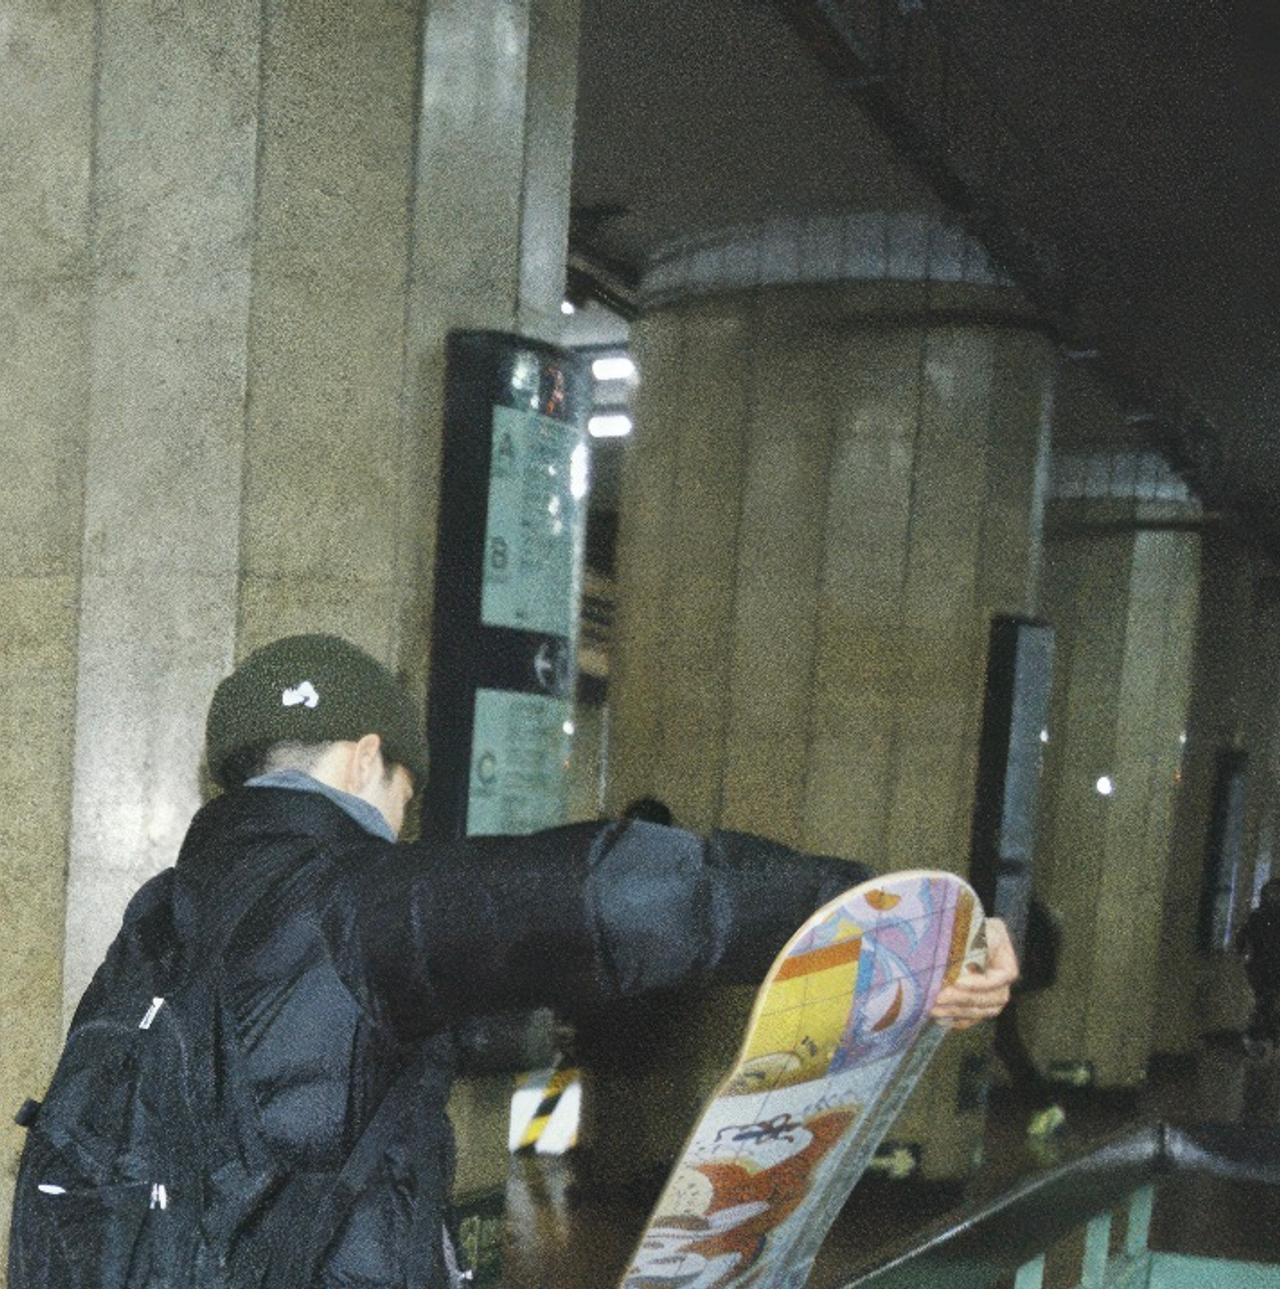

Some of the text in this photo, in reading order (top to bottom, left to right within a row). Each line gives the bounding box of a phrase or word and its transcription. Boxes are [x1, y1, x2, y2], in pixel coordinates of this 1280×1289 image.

[497, 431, 515, 459] A
[491, 537, 508, 569] B
[478, 752, 496, 785] C
